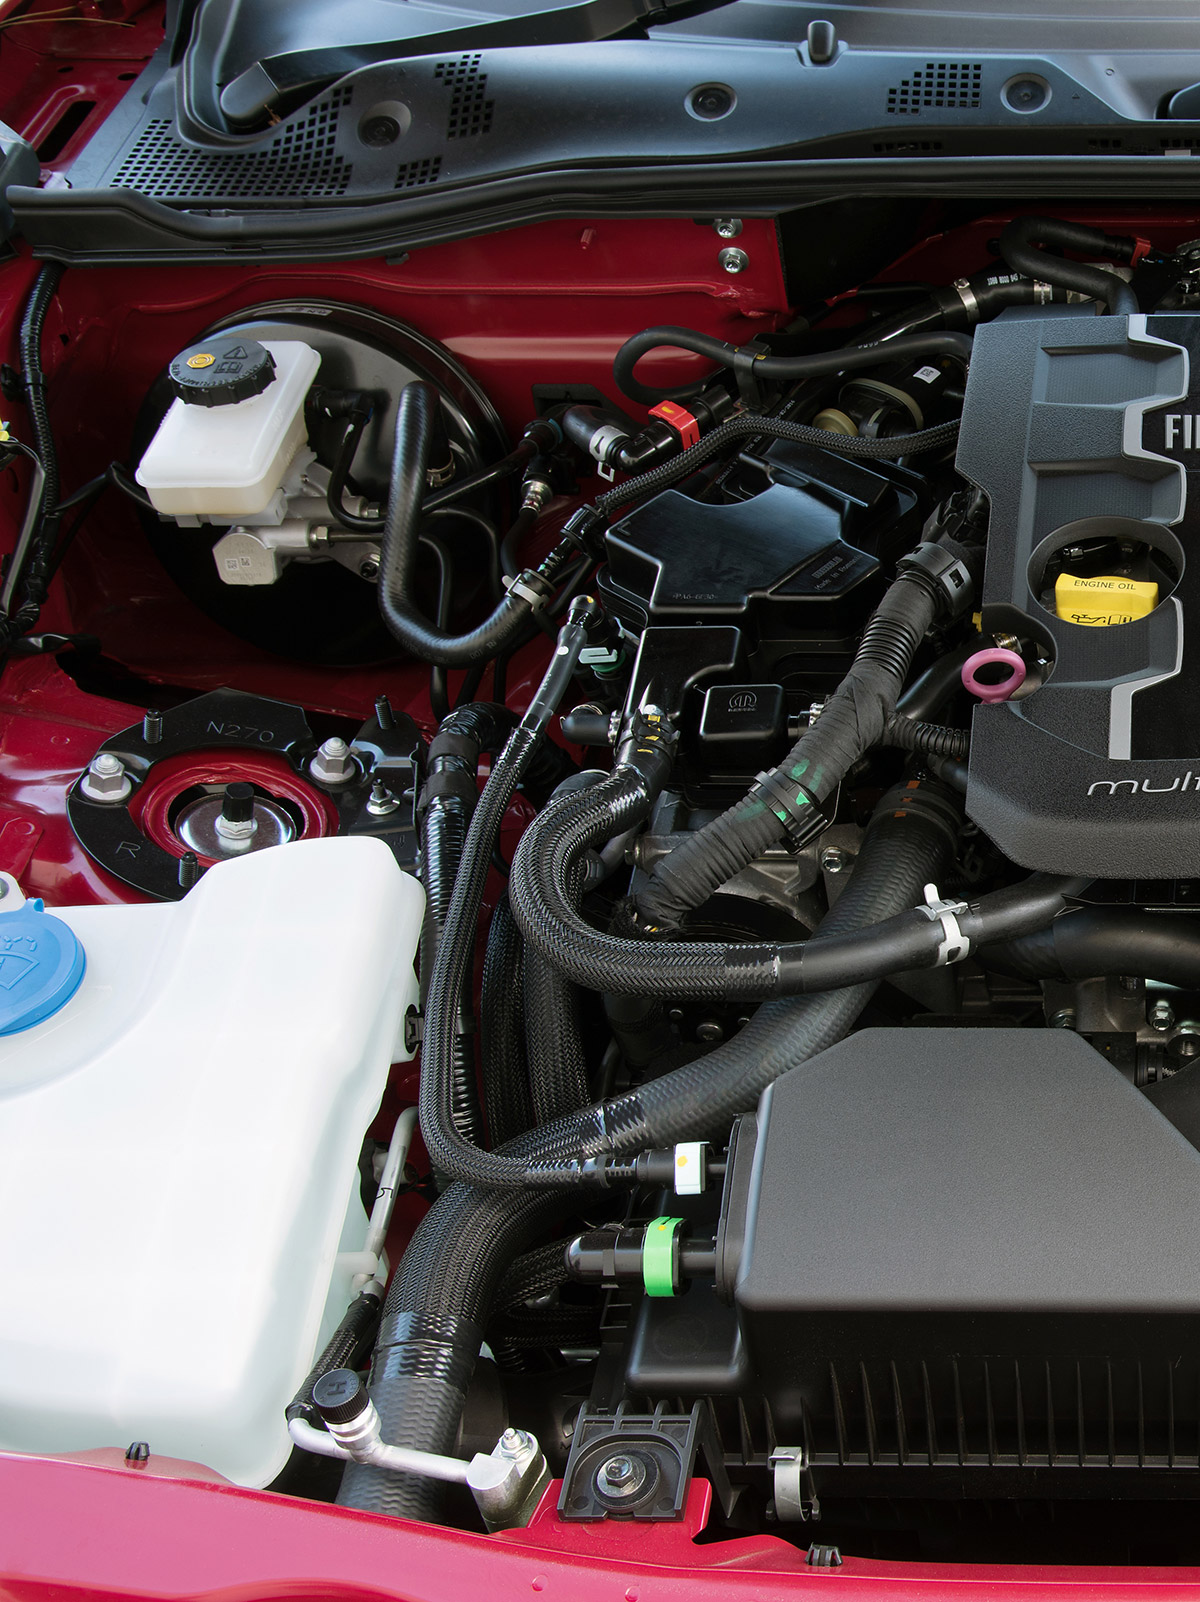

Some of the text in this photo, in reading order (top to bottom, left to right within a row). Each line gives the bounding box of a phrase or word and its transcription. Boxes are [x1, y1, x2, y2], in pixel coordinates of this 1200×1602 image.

[1074, 579, 1136, 590] ENGINE OIL
[206, 720, 275, 743] N270
[115, 841, 141, 858] R
